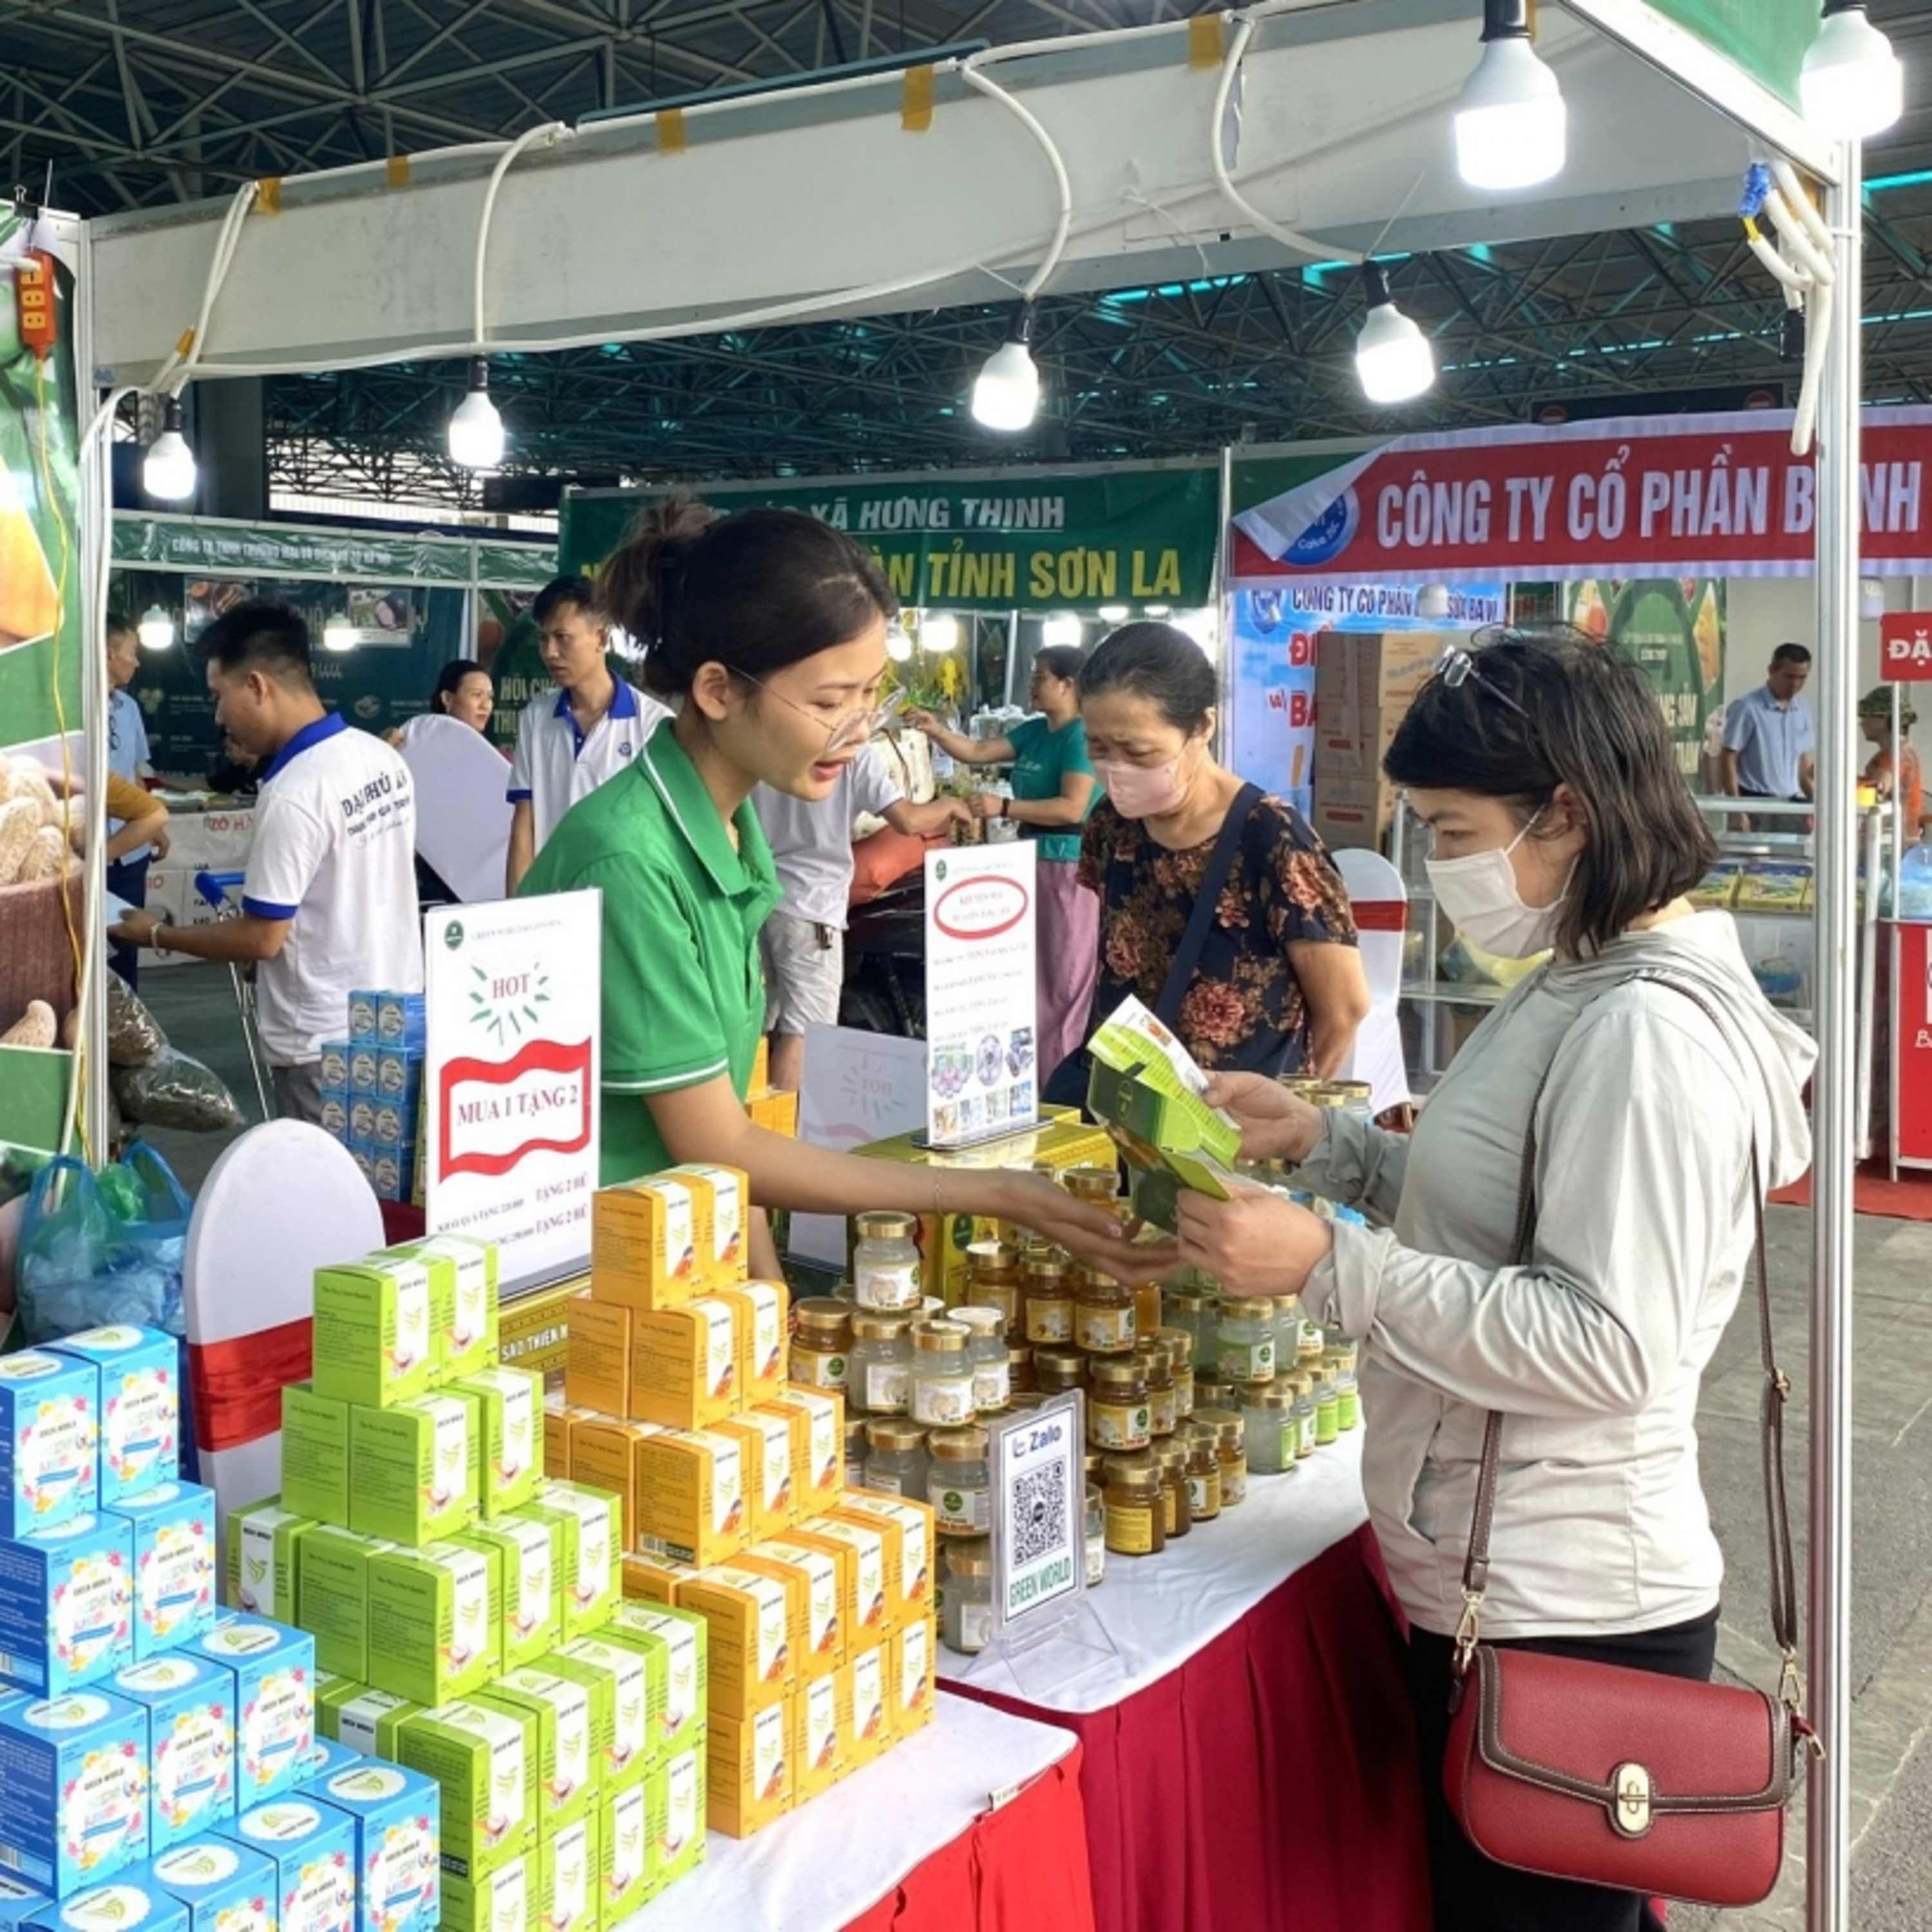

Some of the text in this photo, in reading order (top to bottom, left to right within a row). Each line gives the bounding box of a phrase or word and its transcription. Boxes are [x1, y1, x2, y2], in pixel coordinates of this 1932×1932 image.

[858, 495, 951, 531] HƯNG
[1378, 444, 1922, 548] CÔNG TY CỔ PHẦN BNH
[927, 538, 1015, 598] TỈNH
[1030, 549, 1117, 598] SƠN
[1131, 549, 1181, 597] LA
[493, 973, 531, 999] HOT
[457, 1099, 500, 1126] MUA
[517, 1086, 566, 1117] TẶNG
[570, 1084, 578, 1104] 2
[1029, 1425, 1062, 1452] Zalo
[1009, 1556, 1072, 1608] GREEN WORLD
